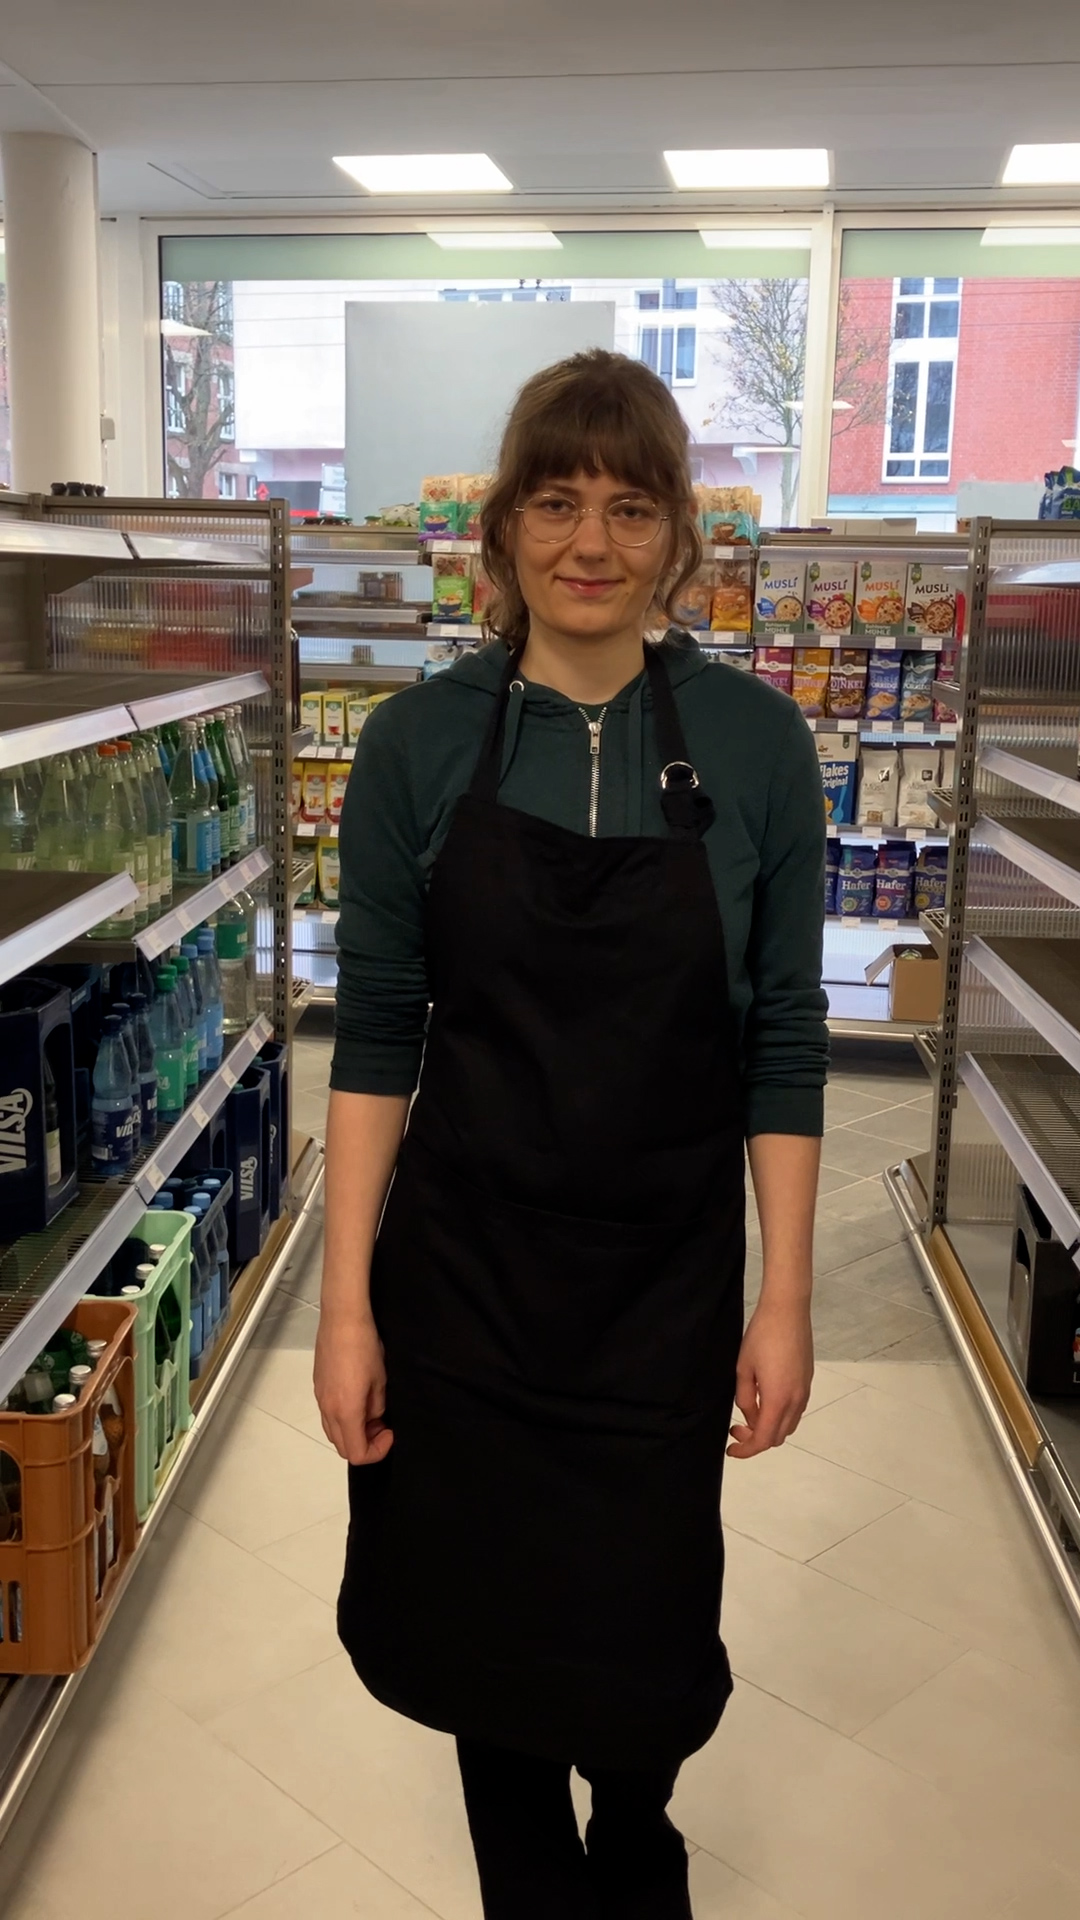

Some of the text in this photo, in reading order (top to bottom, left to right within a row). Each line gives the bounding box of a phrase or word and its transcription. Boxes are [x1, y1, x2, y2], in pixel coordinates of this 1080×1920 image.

[830, 679, 864, 689] DINKEL
[842, 880, 871, 890] Hafer
[877, 879, 906, 890] Hafer
[240, 1156, 258, 1201] VILSA
